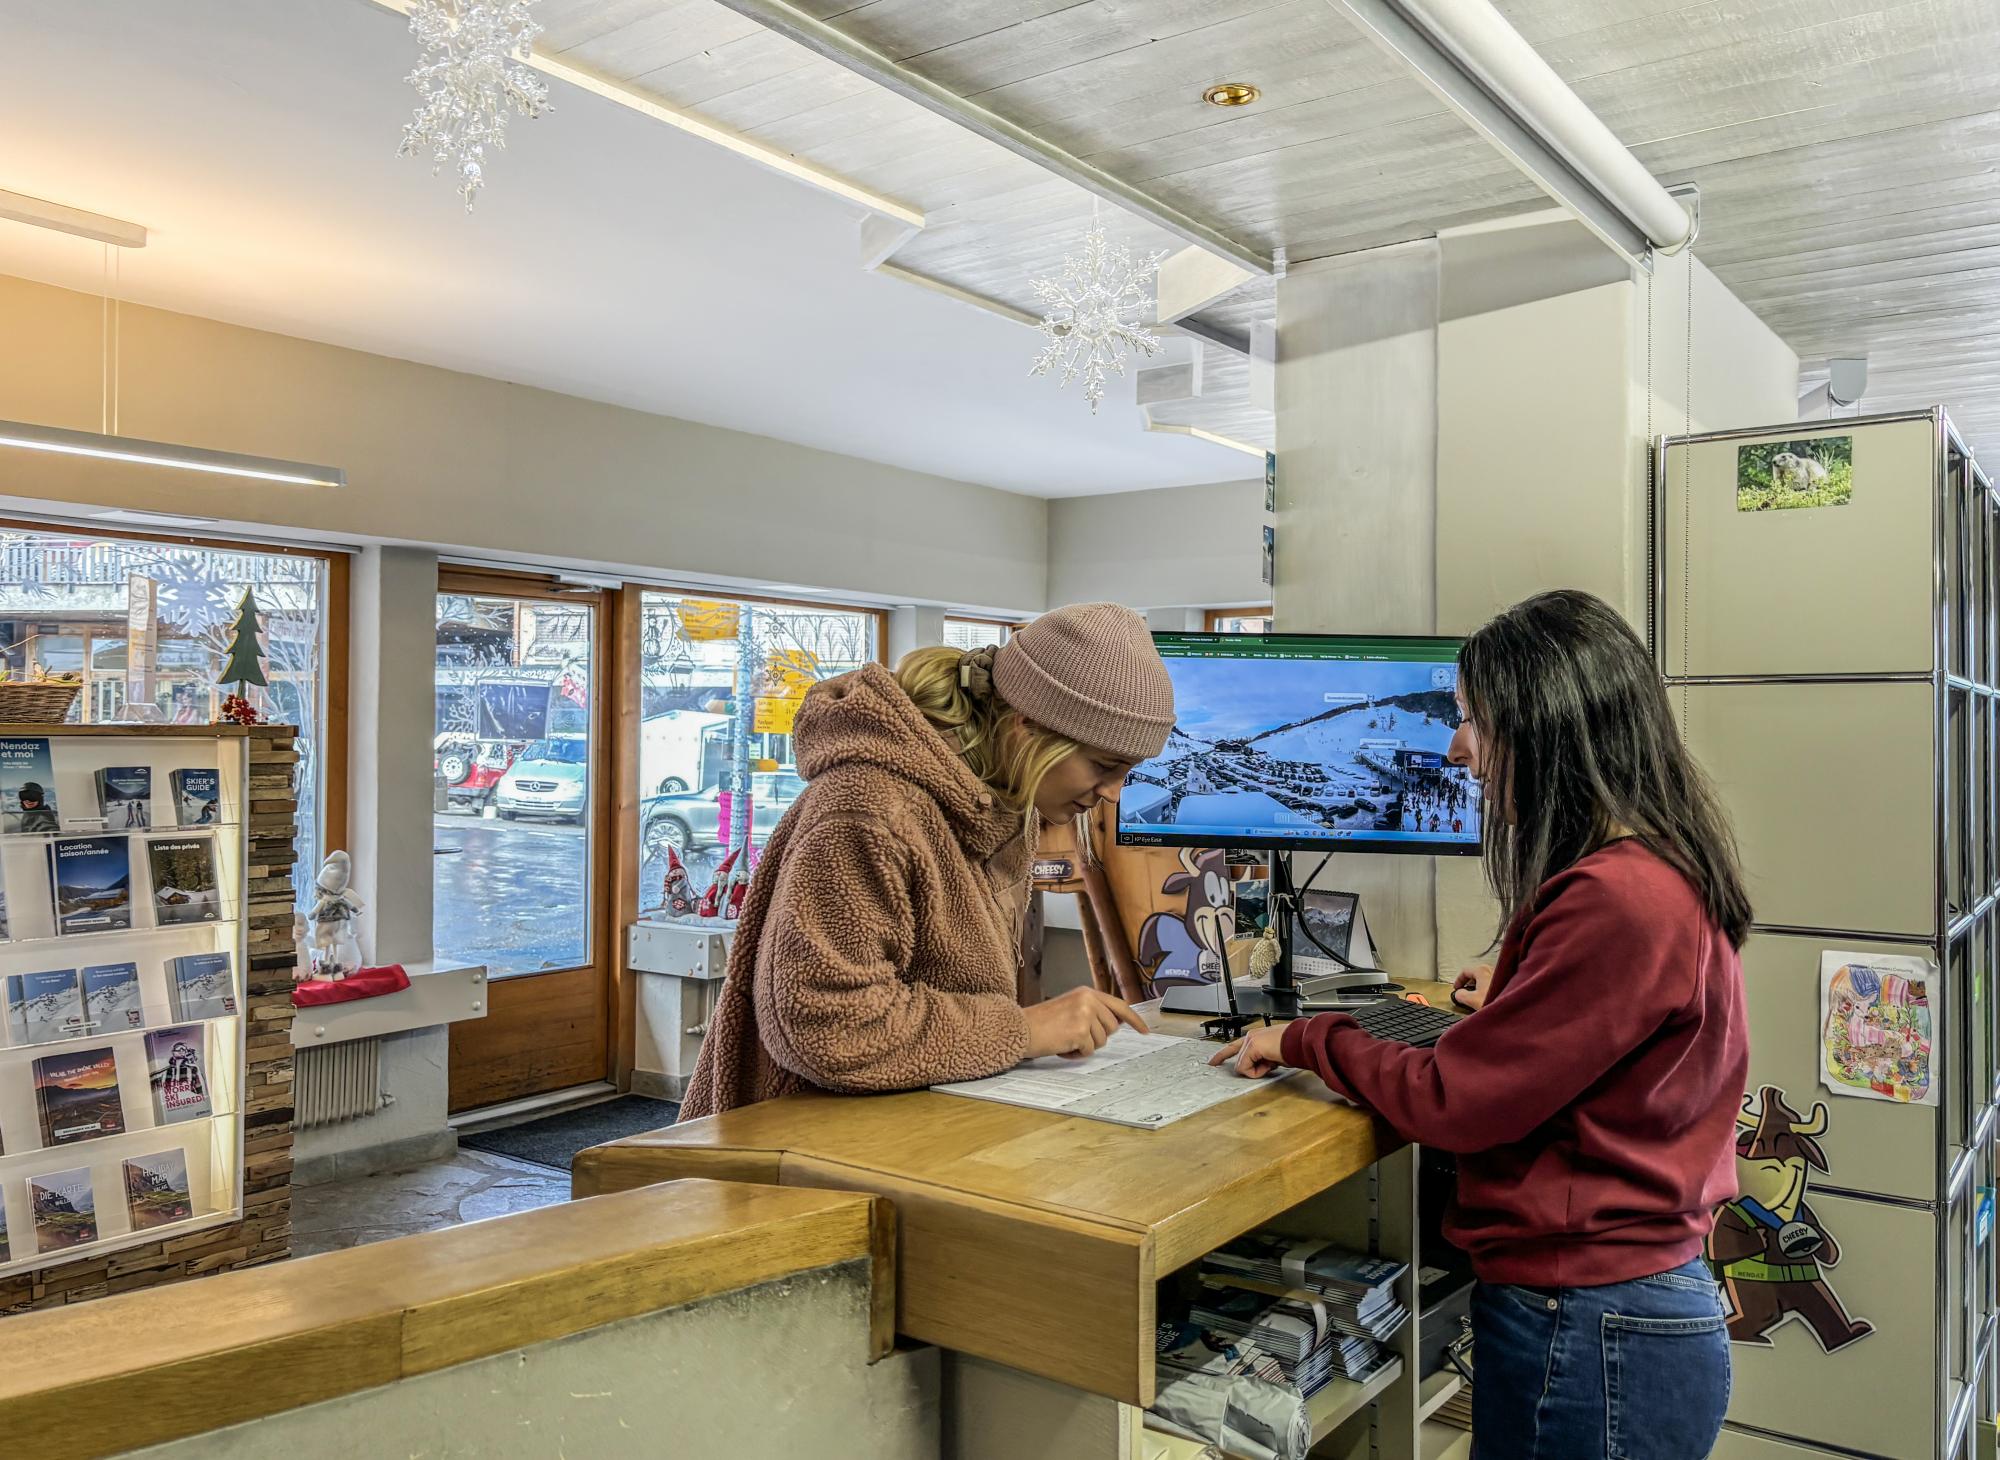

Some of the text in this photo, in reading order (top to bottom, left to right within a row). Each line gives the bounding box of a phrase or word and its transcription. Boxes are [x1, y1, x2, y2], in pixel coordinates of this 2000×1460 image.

[0, 741, 40, 750] Nendaz
[1, 750, 34, 758] et moi
[186, 777, 216, 785] SKIER'S
[59, 843, 93, 851] Location
[169, 843, 181, 851] des
[181, 842, 200, 851] privés
[59, 849, 110, 858] saison/année
[1034, 864, 1065, 875] CHEESY
[1164, 968, 1191, 977] NENDAZ
[164, 1093, 179, 1102] SKI
[142, 1159, 175, 1177] HOLIDAY
[151, 1172, 169, 1185] MAP
[40, 1183, 84, 1201] DIE KARTE
[1782, 1226, 1809, 1244] CHEESY
[1737, 1271, 1765, 1279] NENDAZ
